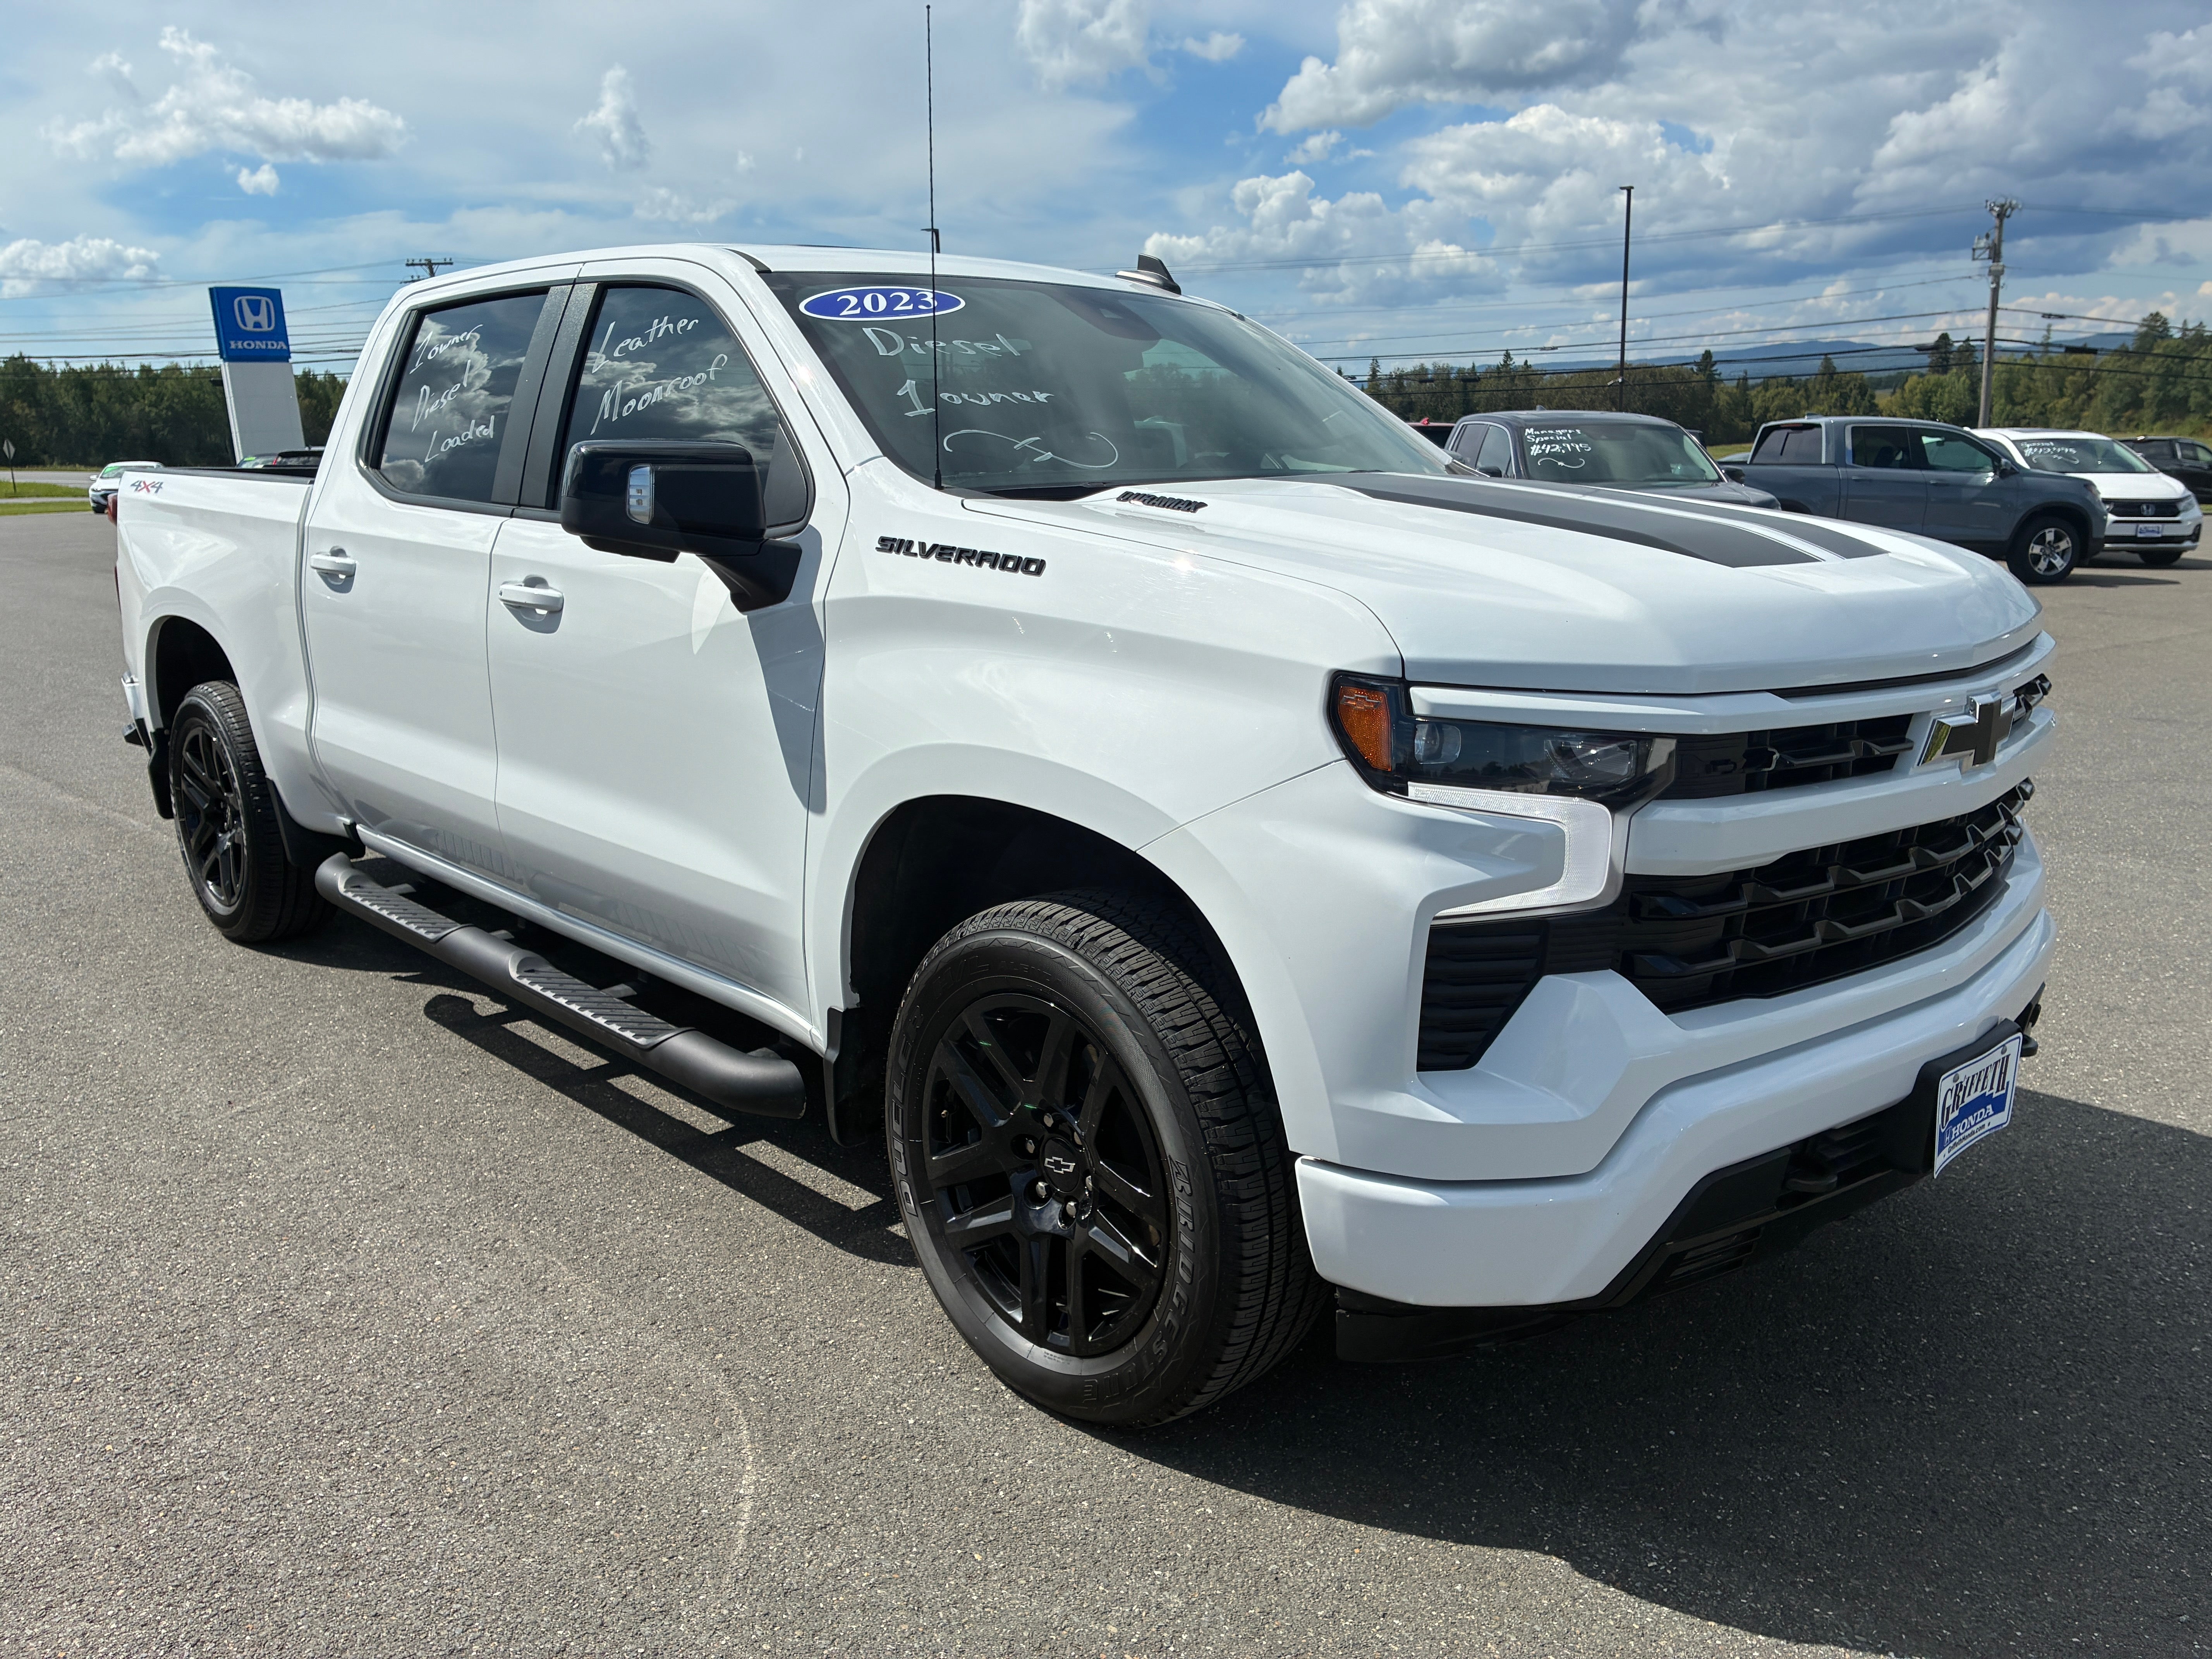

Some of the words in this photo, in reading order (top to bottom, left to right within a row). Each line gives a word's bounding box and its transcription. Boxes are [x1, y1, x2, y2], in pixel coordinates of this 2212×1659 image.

[836, 291, 937, 316] 2023
[230, 340, 287, 350] HONDA
[592, 316, 698, 374] Leather
[862, 327, 1021, 356] Diesel
[412, 360, 471, 433] Diesel
[590, 354, 727, 435] Moonroof
[896, 380, 936, 417] 1
[939, 390, 1054, 406] owner
[425, 415, 494, 463] Loaded
[1527, 434, 1572, 443] Special
[1116, 491, 1205, 514] DURAMAX
[875, 536, 1046, 577] SILVERADO
[1941, 1053, 2011, 1128] GRIFFETH
[890, 1005, 925, 1218] DUELER
[1951, 1104, 1994, 1141] HONDA
[1082, 1154, 1195, 1403] BRIDGESTONE
